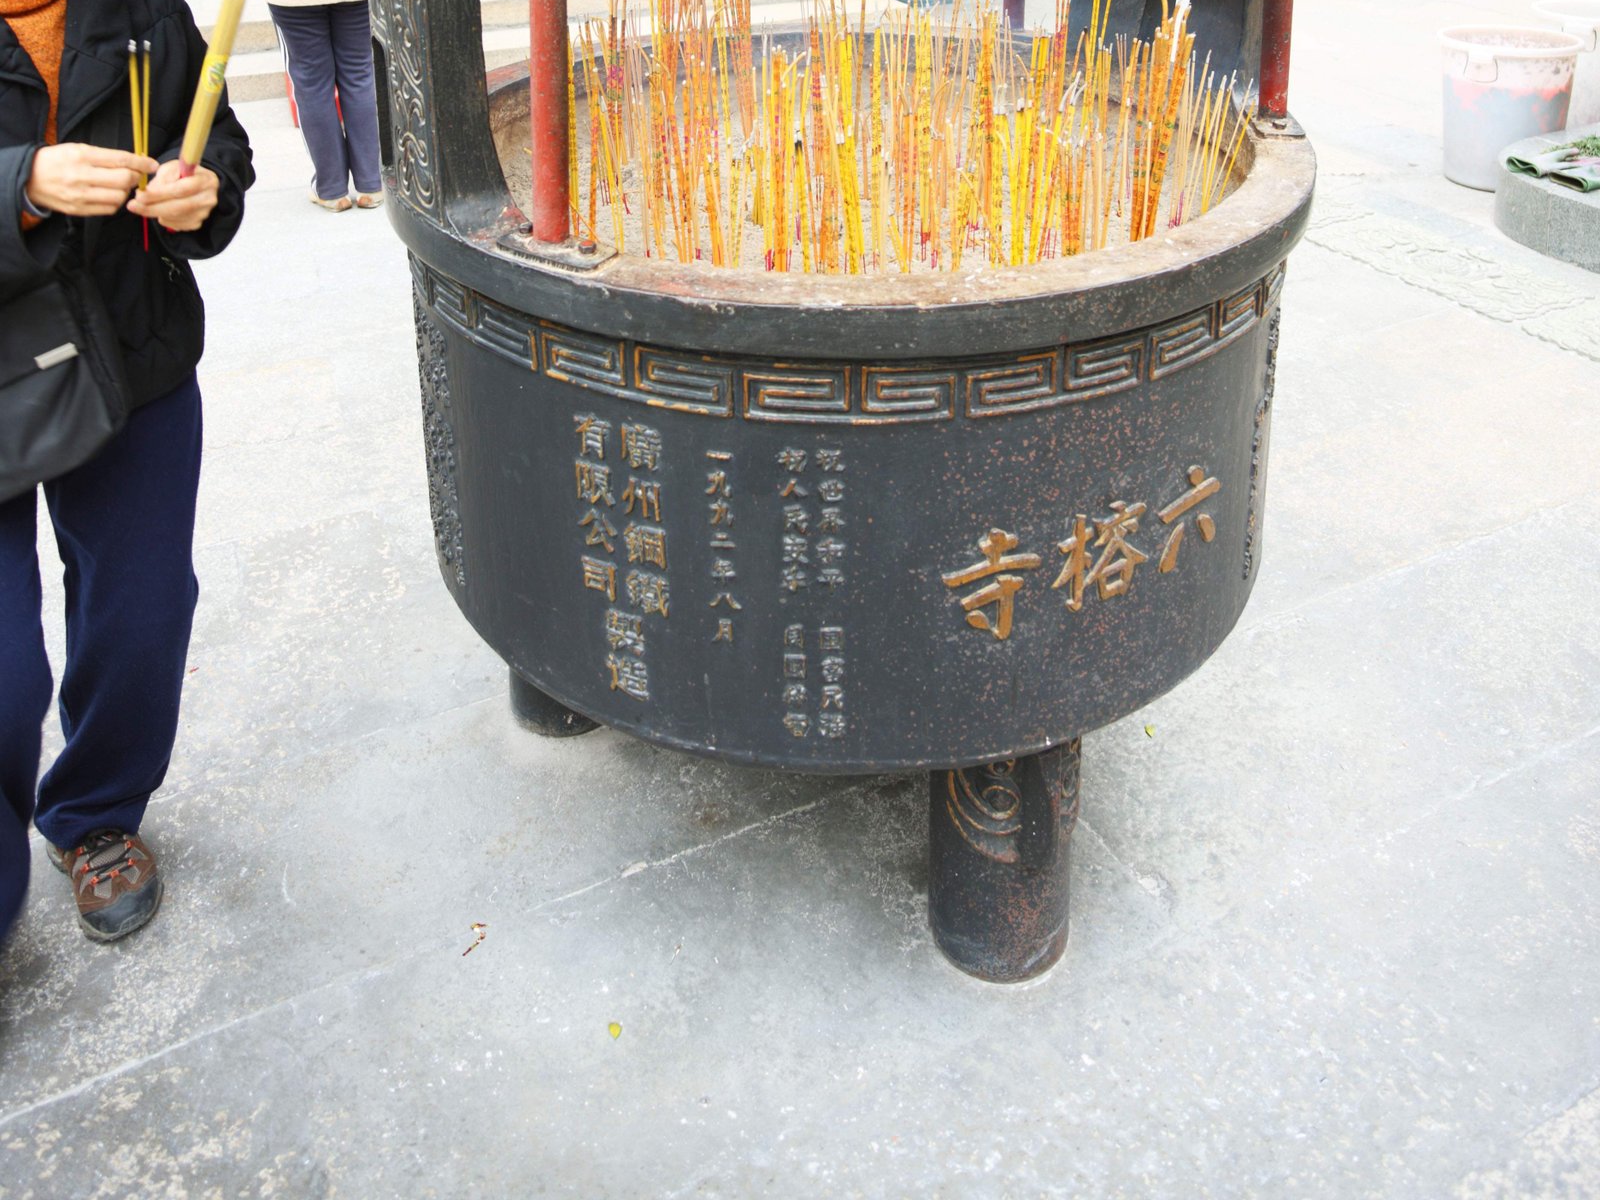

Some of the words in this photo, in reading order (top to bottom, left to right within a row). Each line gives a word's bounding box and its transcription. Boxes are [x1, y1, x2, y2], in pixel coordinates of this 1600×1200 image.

[573, 412, 619, 604] 有限公司
[705, 451, 743, 644] 一九九二年八月
[941, 464, 1222, 641] 六榕寺
[604, 607, 650, 702] 製造
